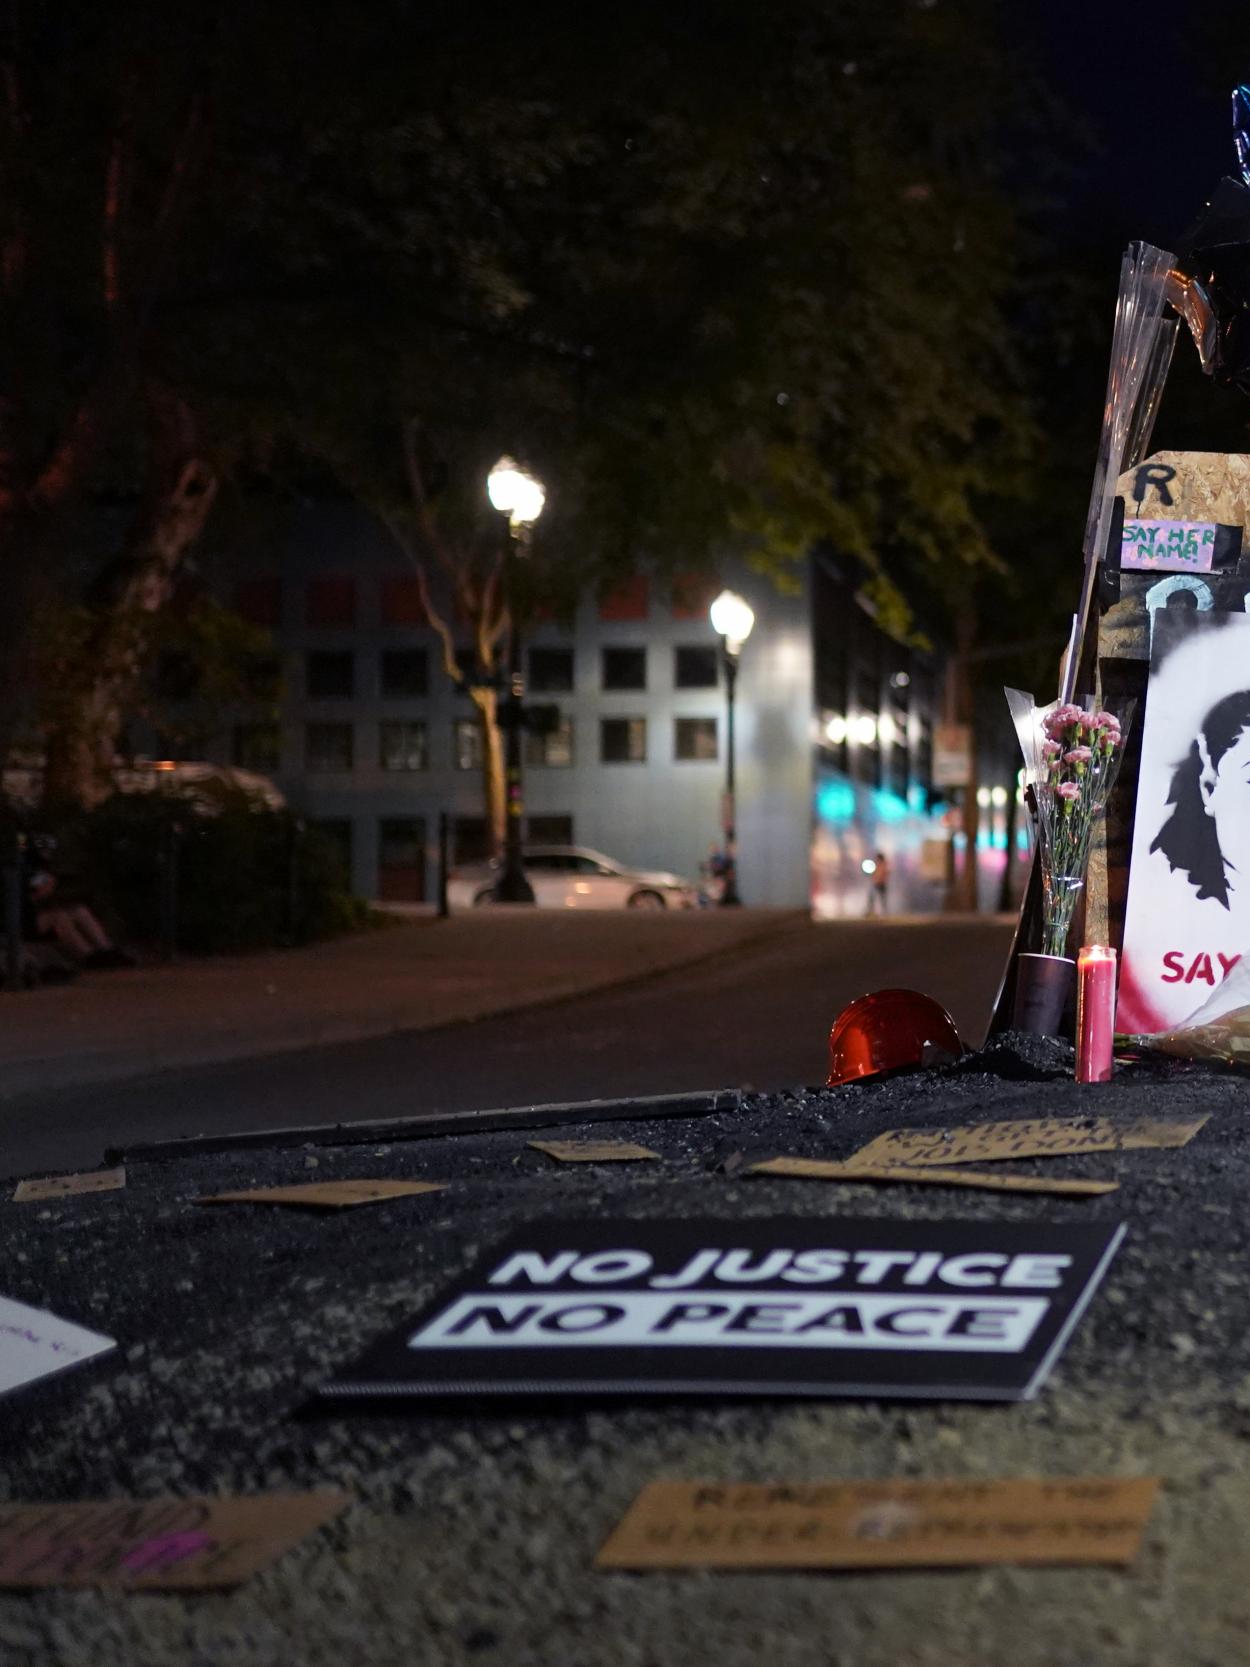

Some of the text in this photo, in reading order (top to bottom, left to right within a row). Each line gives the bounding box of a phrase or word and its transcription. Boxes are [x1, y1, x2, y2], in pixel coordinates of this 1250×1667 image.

[1132, 463, 1177, 507] R
[1122, 525, 1215, 545] SAY HER
[1137, 541, 1199, 563] NAME!
[1161, 951, 1242, 986] SAY
[488, 1248, 1073, 1288] NO JUSTICE
[440, 1303, 1020, 1341] NO PEACE
